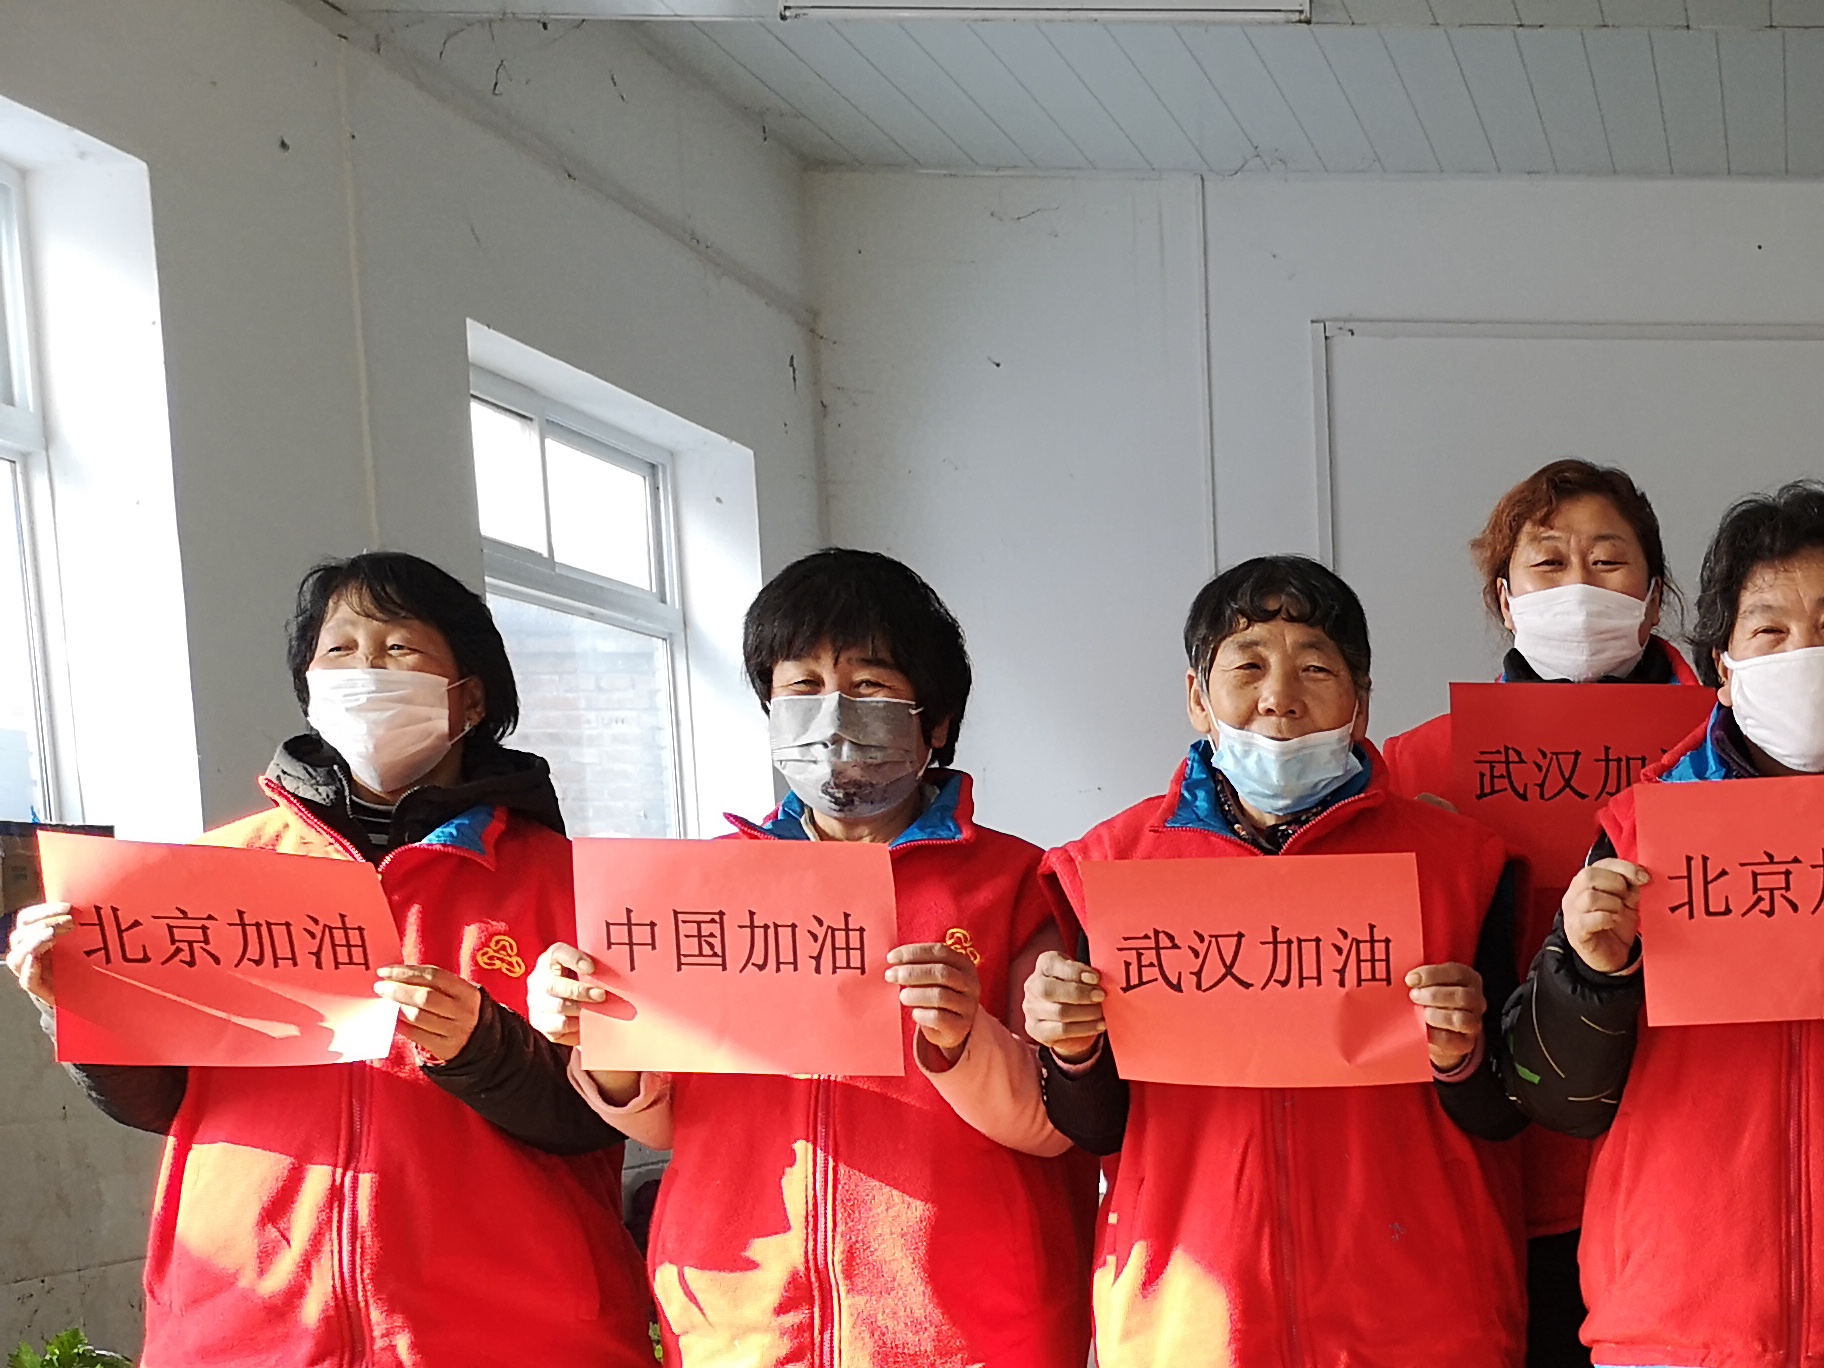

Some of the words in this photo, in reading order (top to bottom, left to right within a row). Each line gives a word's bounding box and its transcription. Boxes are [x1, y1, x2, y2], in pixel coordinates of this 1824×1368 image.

[1474, 744, 1668, 802] 武汉加
[78, 903, 371, 970] 北京加油
[605, 906, 867, 977] 中国加油
[1116, 924, 1394, 995] 武汉加油
